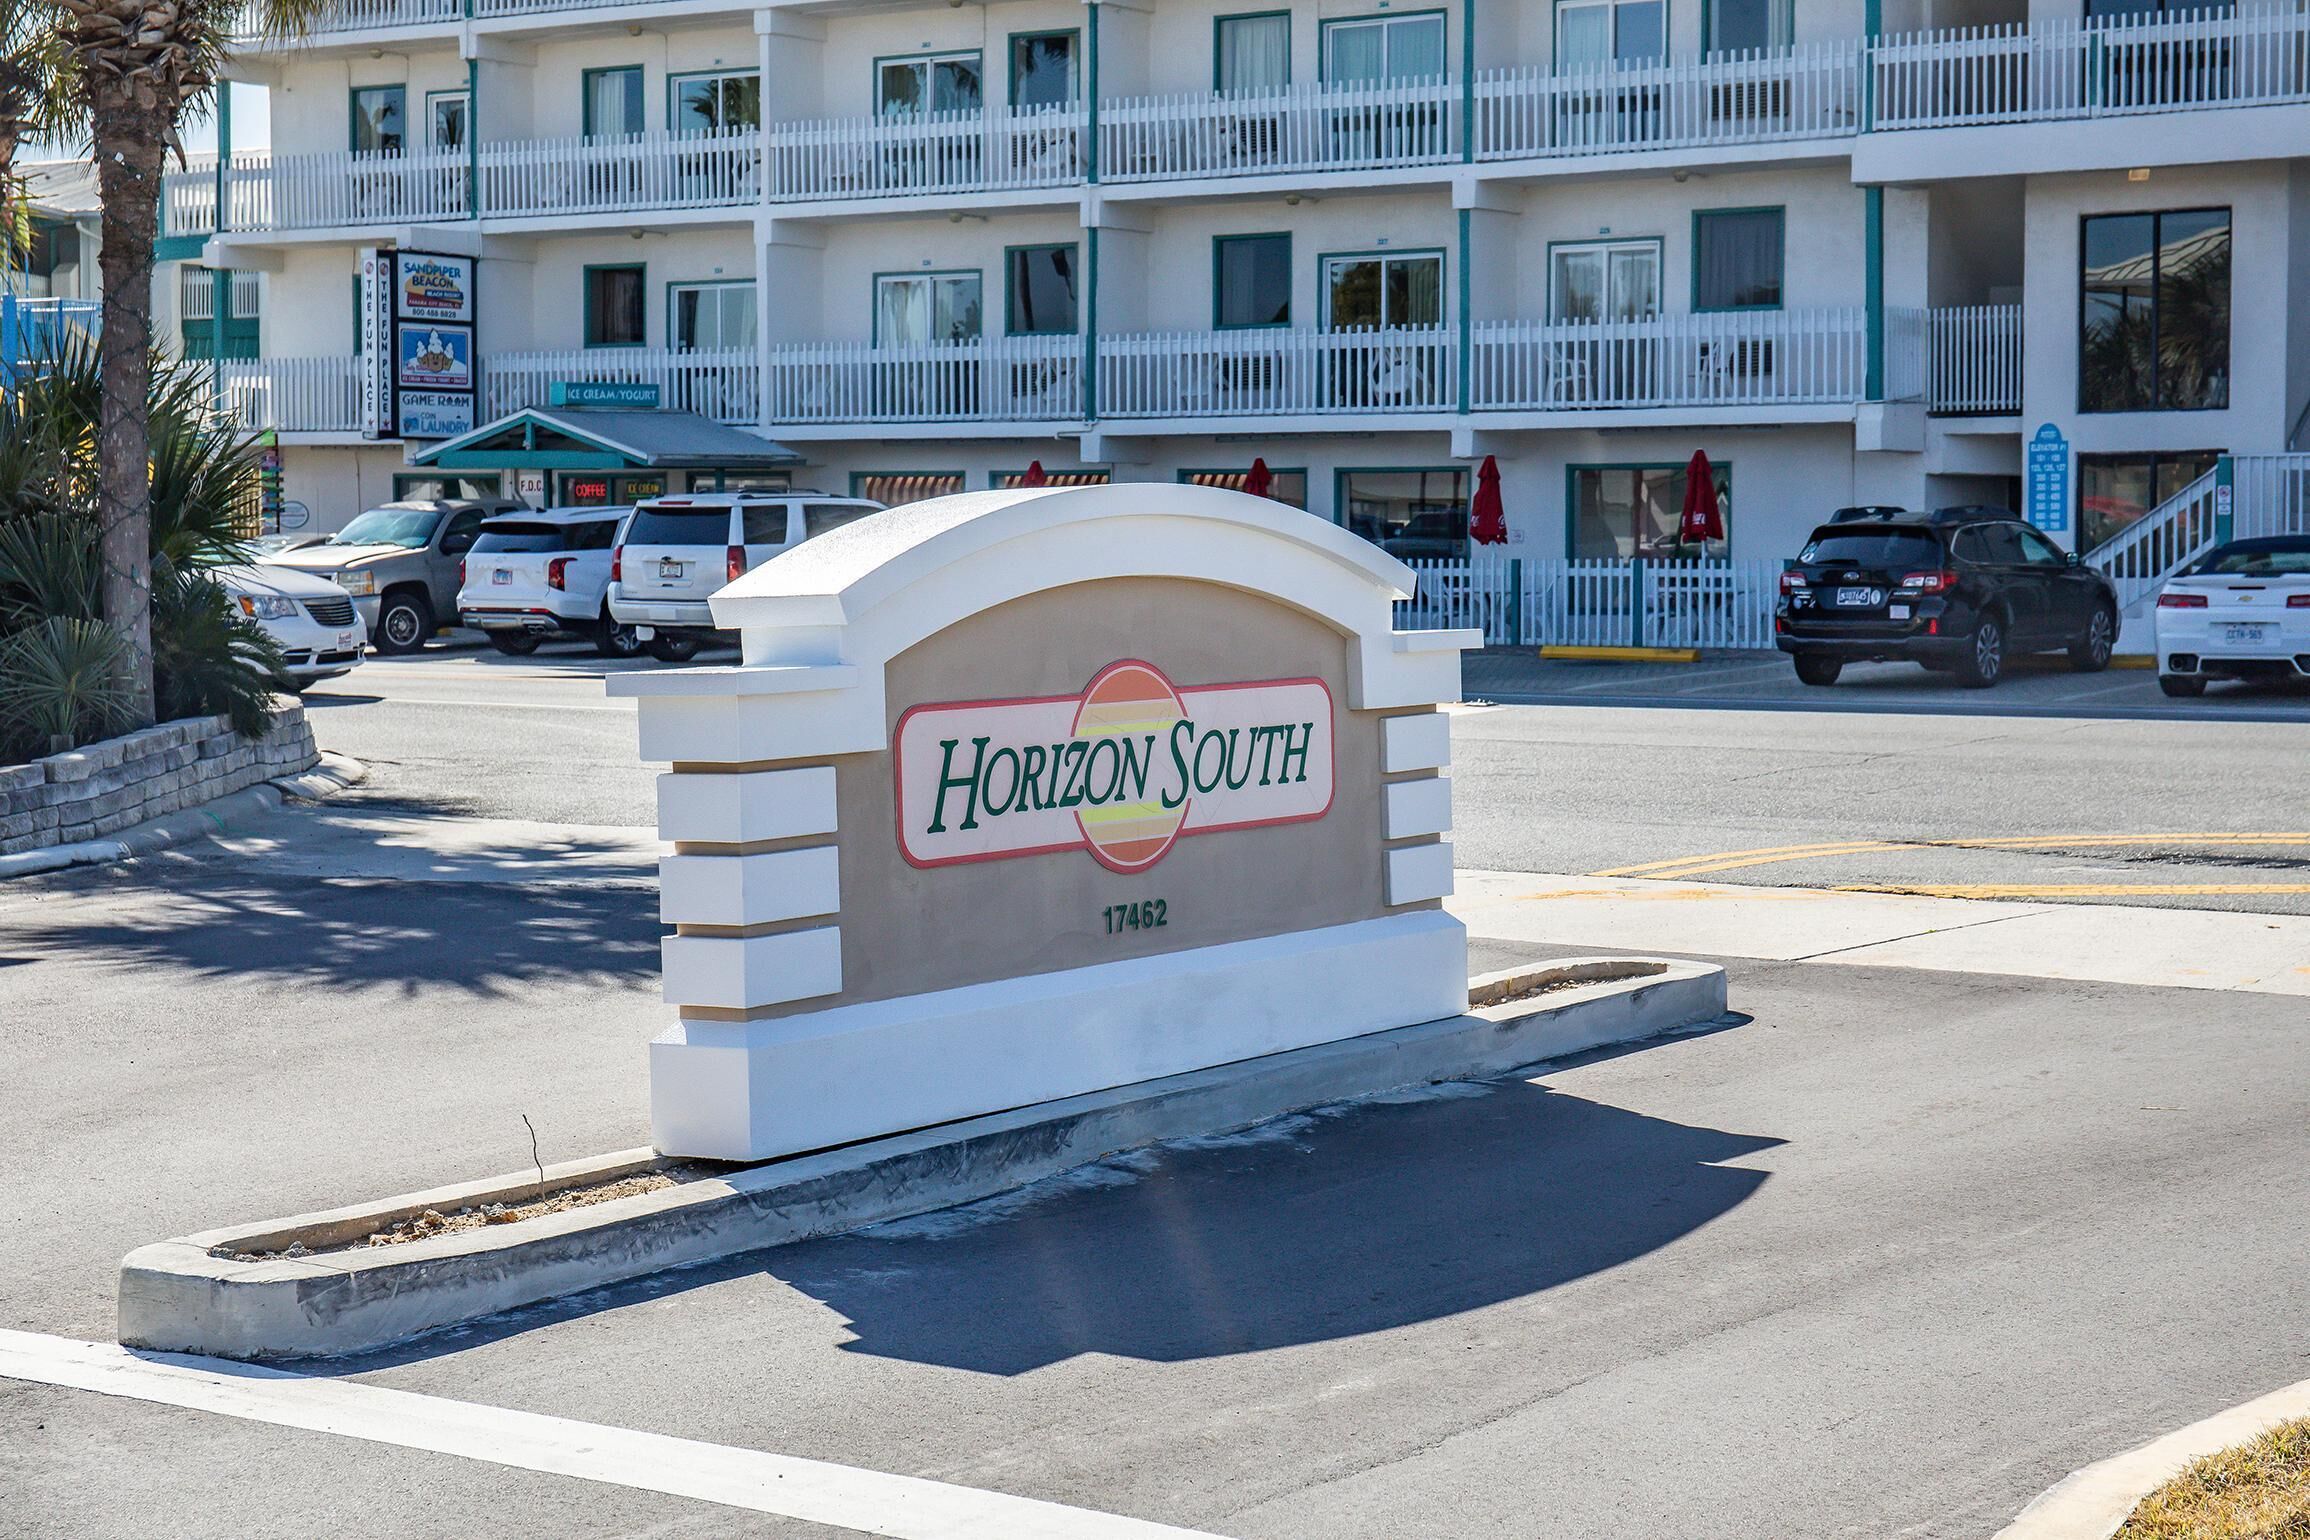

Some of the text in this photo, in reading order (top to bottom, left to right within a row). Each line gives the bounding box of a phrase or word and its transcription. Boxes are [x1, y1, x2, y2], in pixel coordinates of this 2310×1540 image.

[404, 262, 461, 278] SANDPIPER
[412, 275, 454, 288] BEACON
[412, 308, 425, 316] 800
[402, 394, 470, 408] GAME ROOM
[567, 388, 656, 400] ICE CREAM/YOGURT
[420, 419, 469, 434] LAUNDRY
[520, 480, 544, 492] F.D.C.
[575, 483, 607, 497] COFFEE
[927, 719, 1314, 834] HORIZON SOUTH
[1103, 898, 1168, 934] 17462
